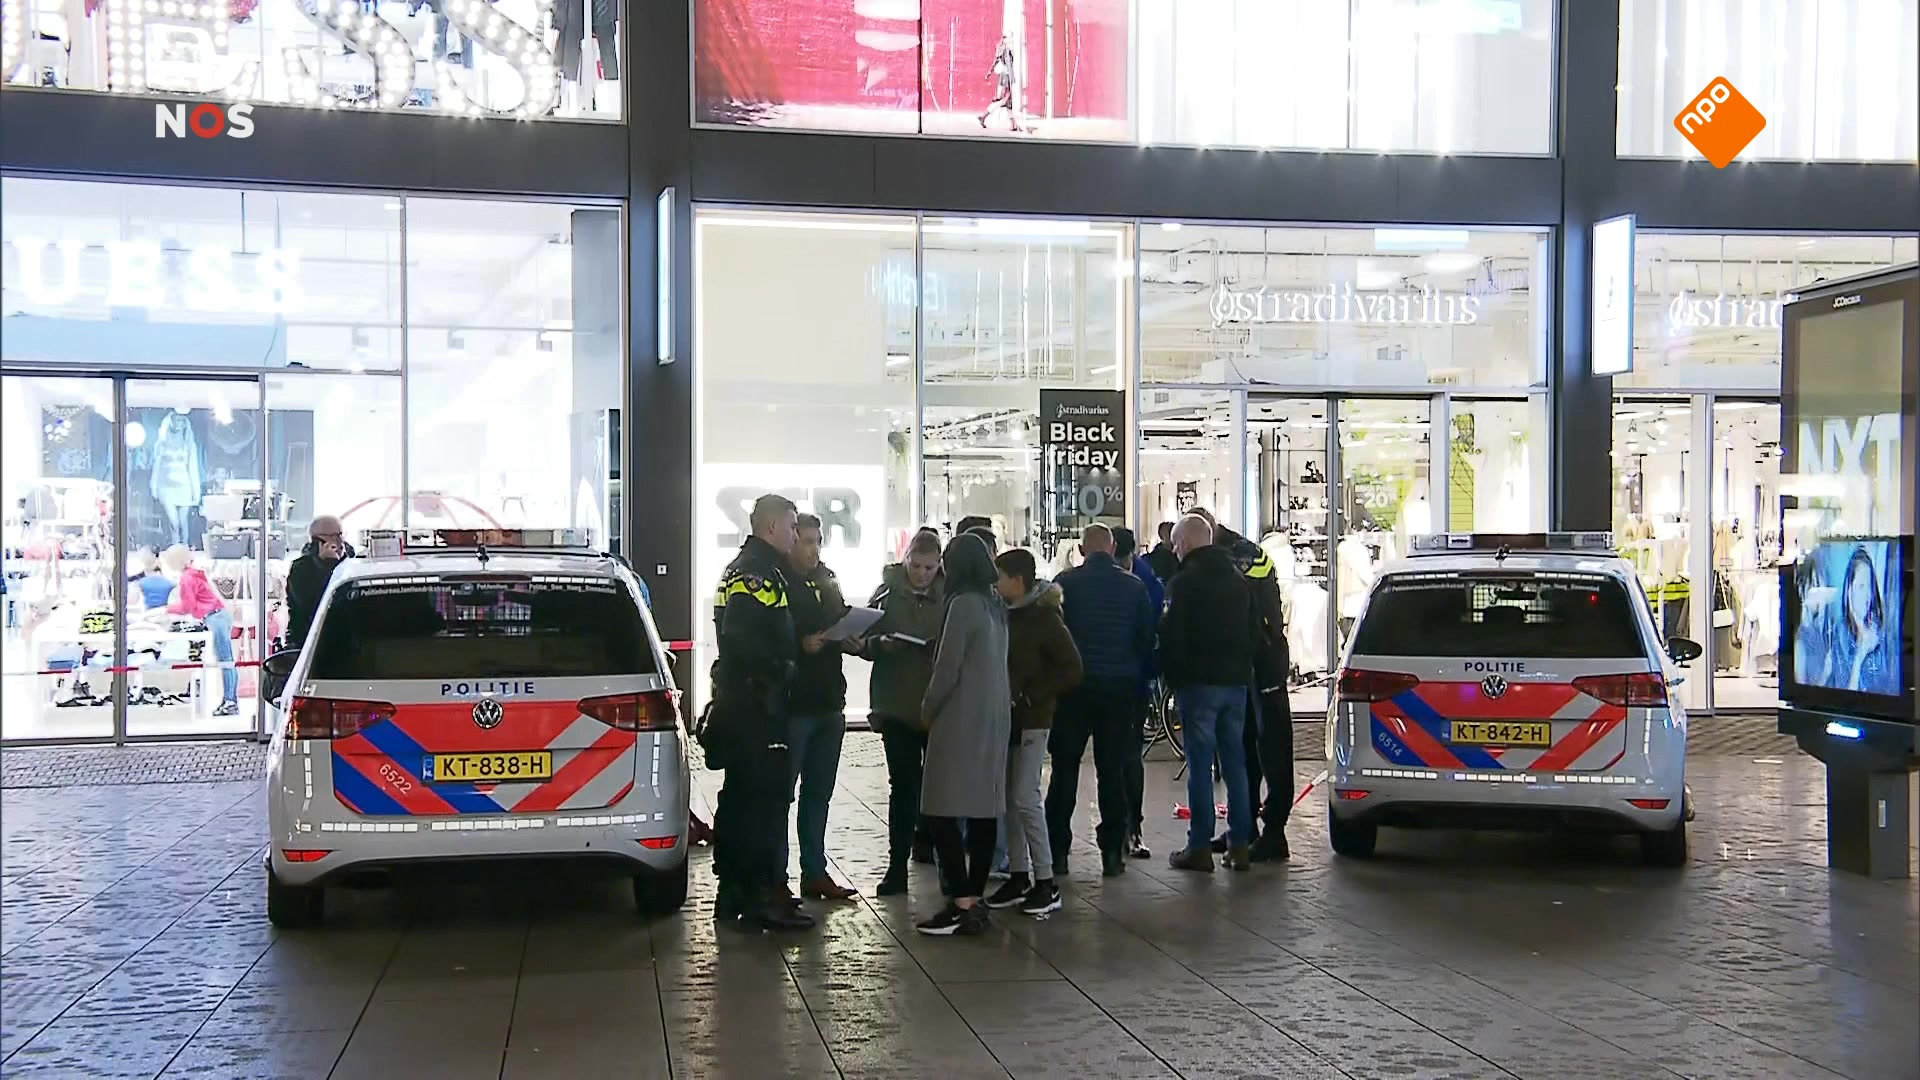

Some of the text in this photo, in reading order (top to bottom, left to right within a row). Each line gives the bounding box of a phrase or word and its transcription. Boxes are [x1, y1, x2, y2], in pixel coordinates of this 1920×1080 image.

[1234, 283, 1480, 324] stradivarius
[1061, 404, 1110, 416] stradivarius
[1050, 421, 1116, 443] Black
[1464, 661, 1526, 673] POLITIE
[440, 681, 536, 696] POLITIE
[1378, 731, 1403, 757] 6514
[1457, 724, 1543, 742] KT-842-H
[443, 755, 544, 777] KT-838-H
[379, 763, 412, 794] 6522
